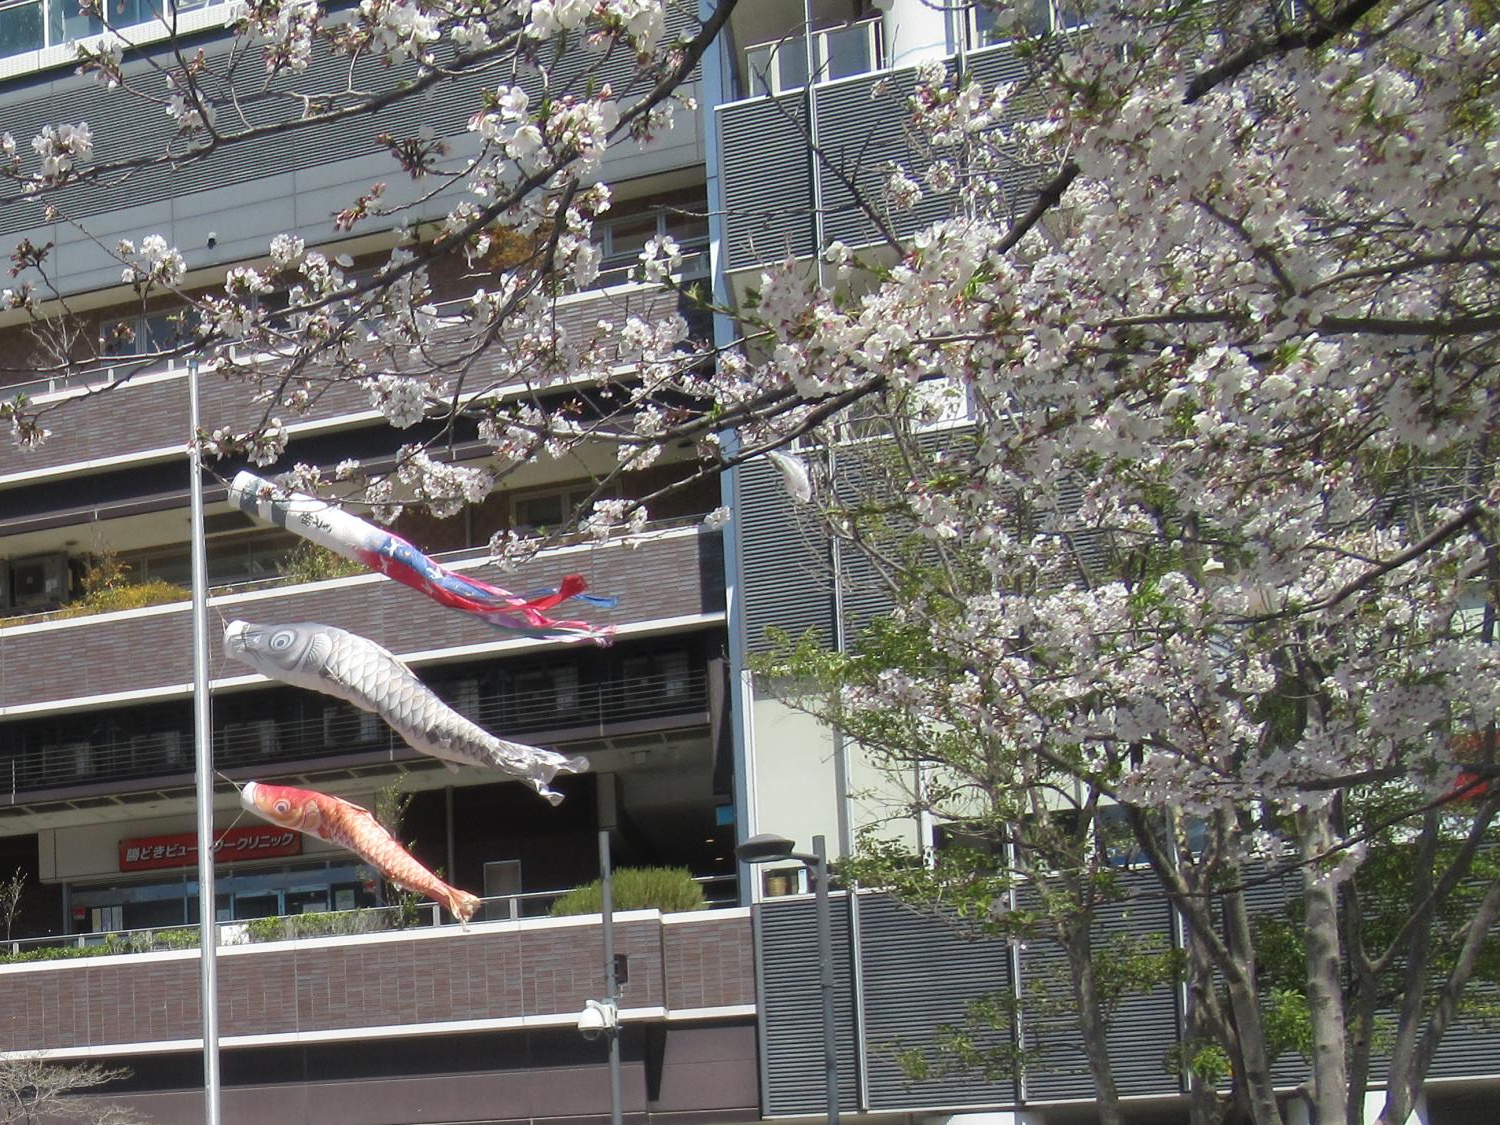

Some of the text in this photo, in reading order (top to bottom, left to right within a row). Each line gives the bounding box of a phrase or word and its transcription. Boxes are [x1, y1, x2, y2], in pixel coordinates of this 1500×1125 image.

[126, 832, 294, 863] 勝どきビューワークリニック
